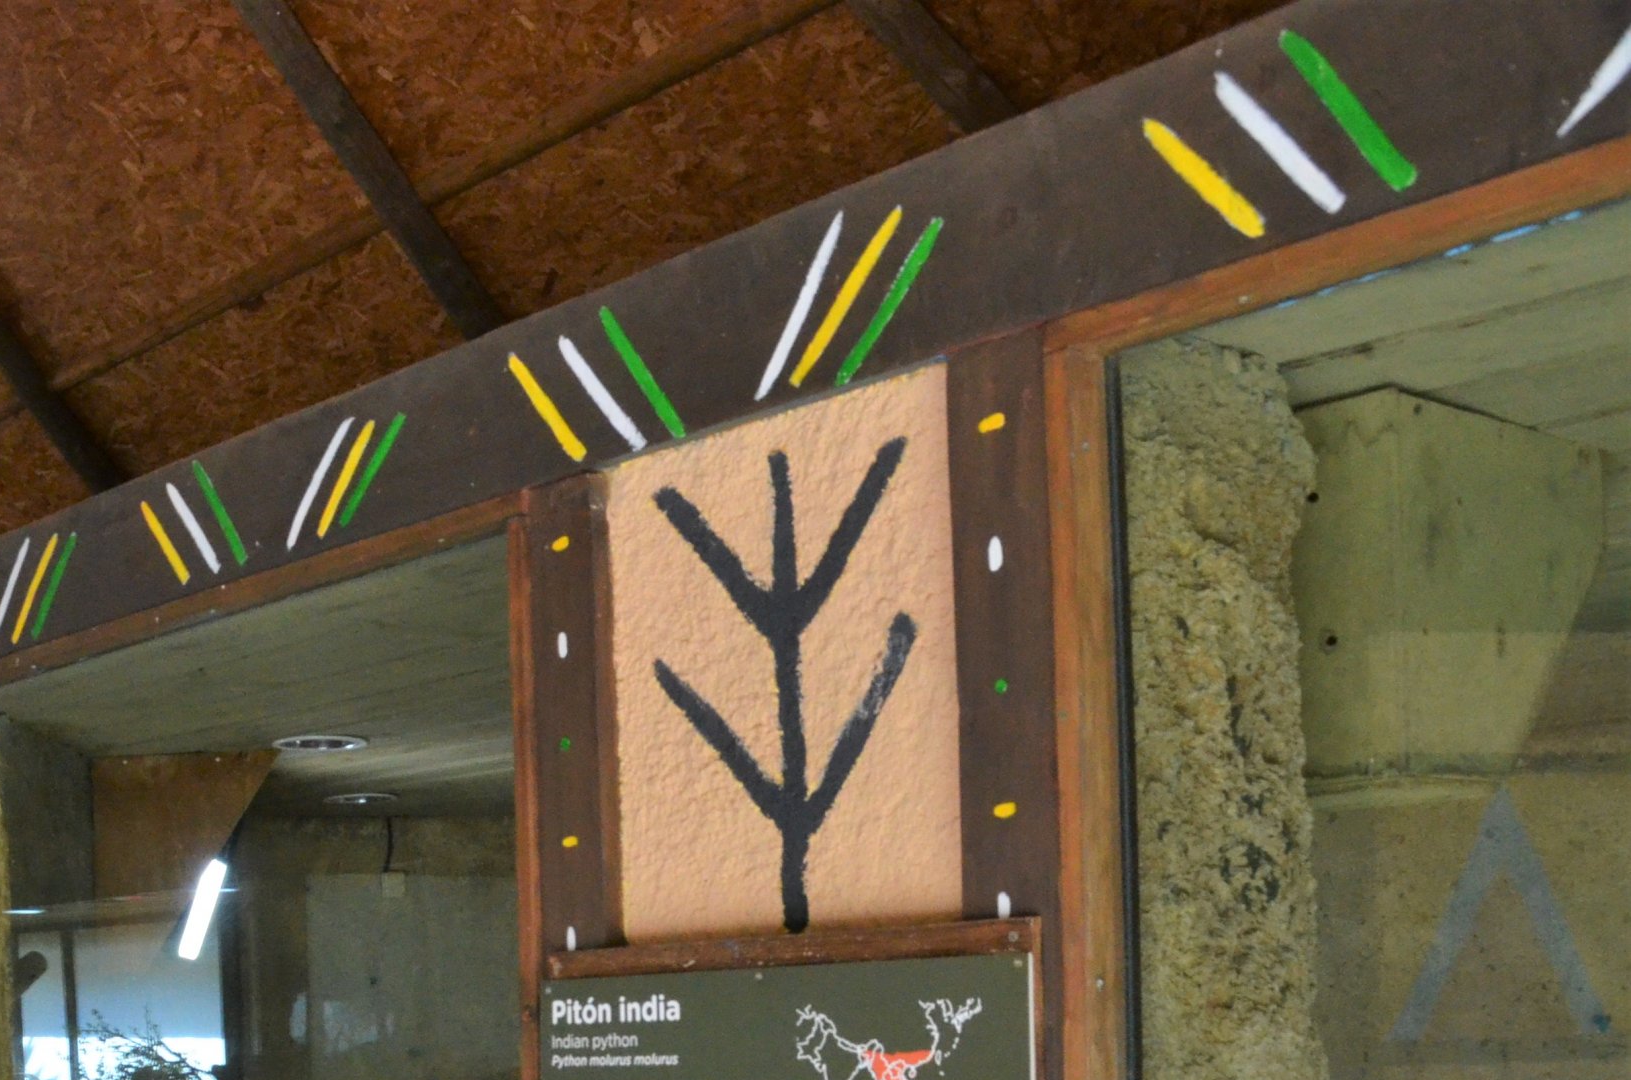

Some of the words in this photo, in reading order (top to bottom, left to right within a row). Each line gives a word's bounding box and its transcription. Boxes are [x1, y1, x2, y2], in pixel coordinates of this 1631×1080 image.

[552, 996, 611, 1025] Pitón
[619, 994, 680, 1023] india
[552, 1034, 589, 1049] Indian
[592, 1033, 638, 1051] python
[552, 1054, 587, 1070] Python
[589, 1054, 631, 1066] molurus
[634, 1053, 679, 1066] molurus
